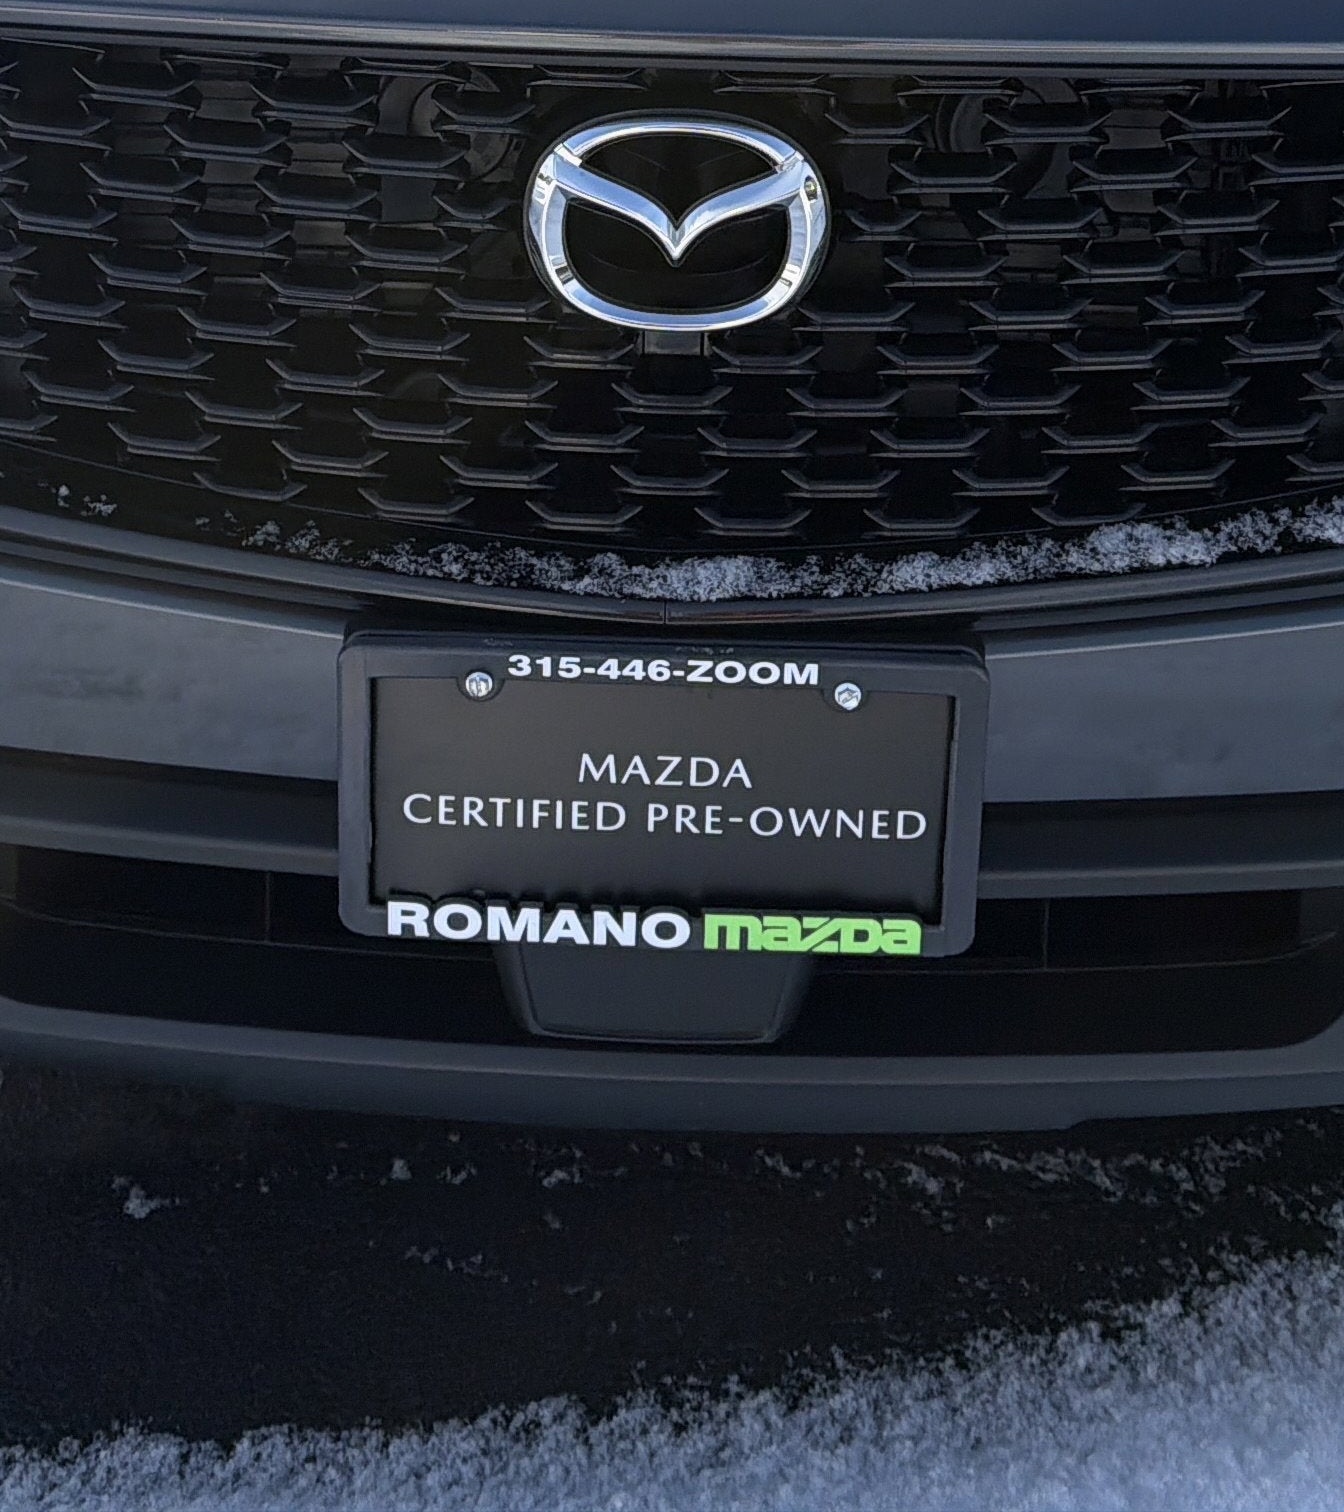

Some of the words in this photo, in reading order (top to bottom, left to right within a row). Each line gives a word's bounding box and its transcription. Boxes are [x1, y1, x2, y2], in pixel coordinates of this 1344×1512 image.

[508, 655, 818, 685] 315-446-ZOOM
[579, 753, 752, 788] MAZDA
[404, 794, 625, 830] CERTIFIED
[648, 804, 926, 839] PRE-OWNED
[388, 901, 690, 948] ROMANO
